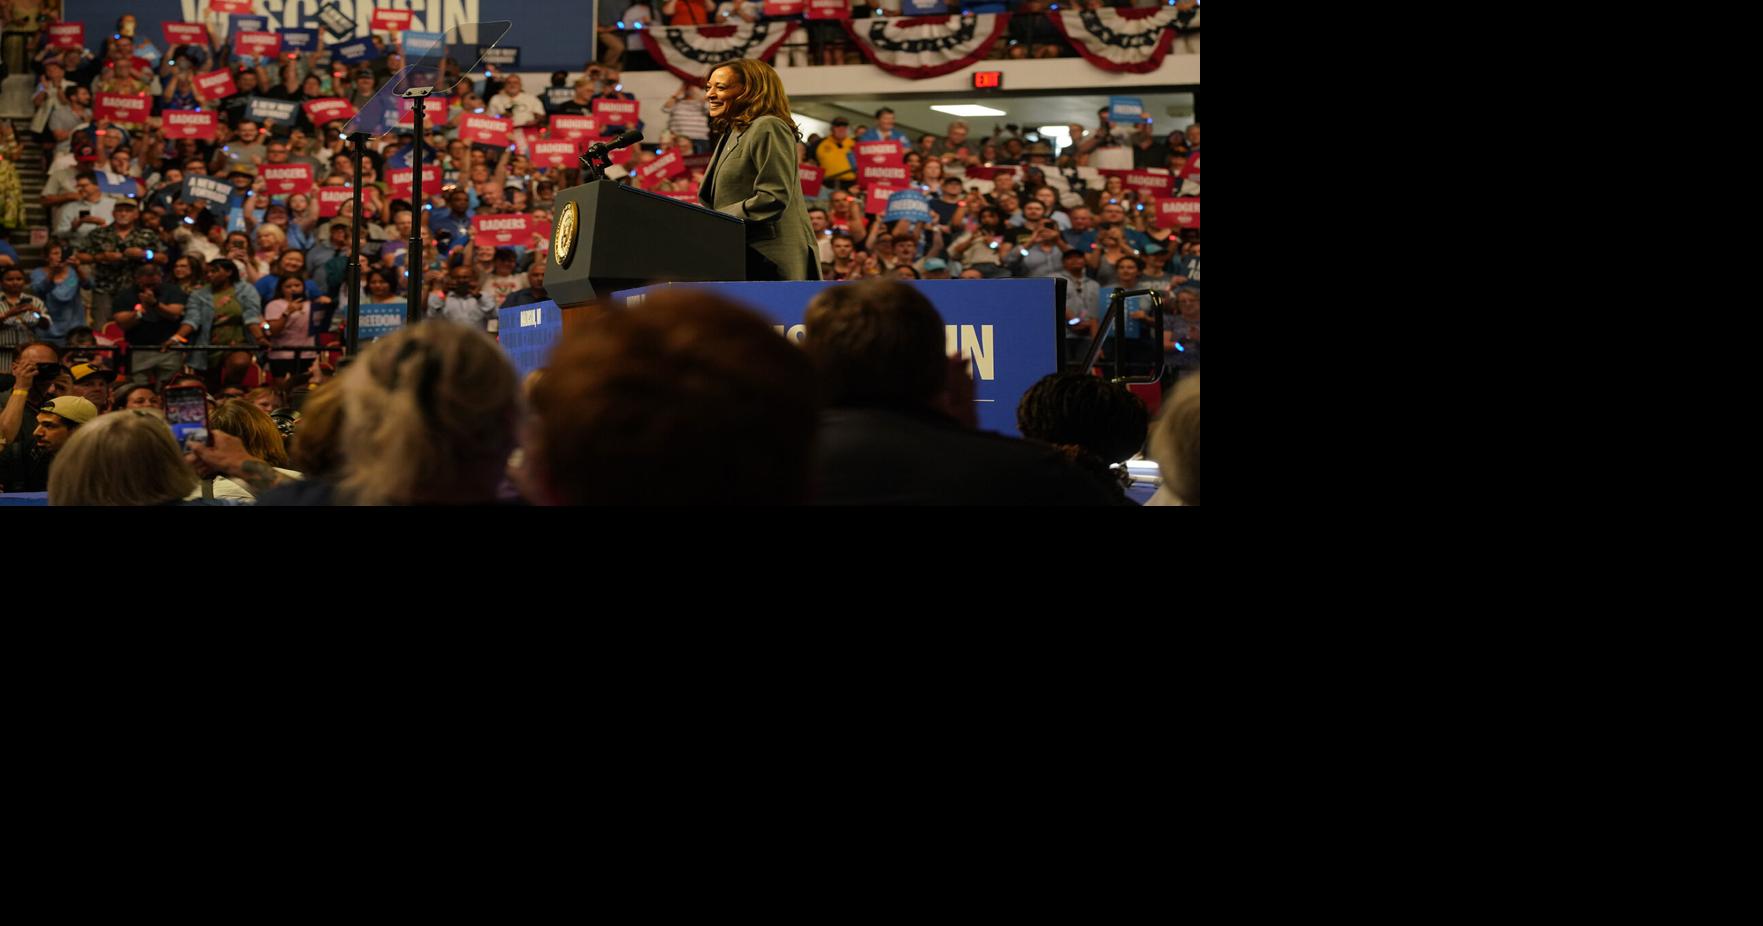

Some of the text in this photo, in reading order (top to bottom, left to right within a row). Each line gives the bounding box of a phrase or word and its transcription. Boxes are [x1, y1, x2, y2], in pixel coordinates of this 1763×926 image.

[242, 34, 276, 45] BADGERS
[103, 97, 144, 110] BADGERS
[169, 114, 211, 125] BADGERS
[466, 117, 508, 133] BADGERS
[555, 118, 595, 130] BADGERS
[535, 143, 574, 154] BADGERS
[860, 144, 897, 155] BADGERS
[642, 152, 677, 175] BADGERS
[265, 168, 307, 180] BADGERS
[864, 167, 906, 179] BADGERS
[1126, 174, 1168, 188] BADGERS
[479, 217, 526, 232] BADGERS
